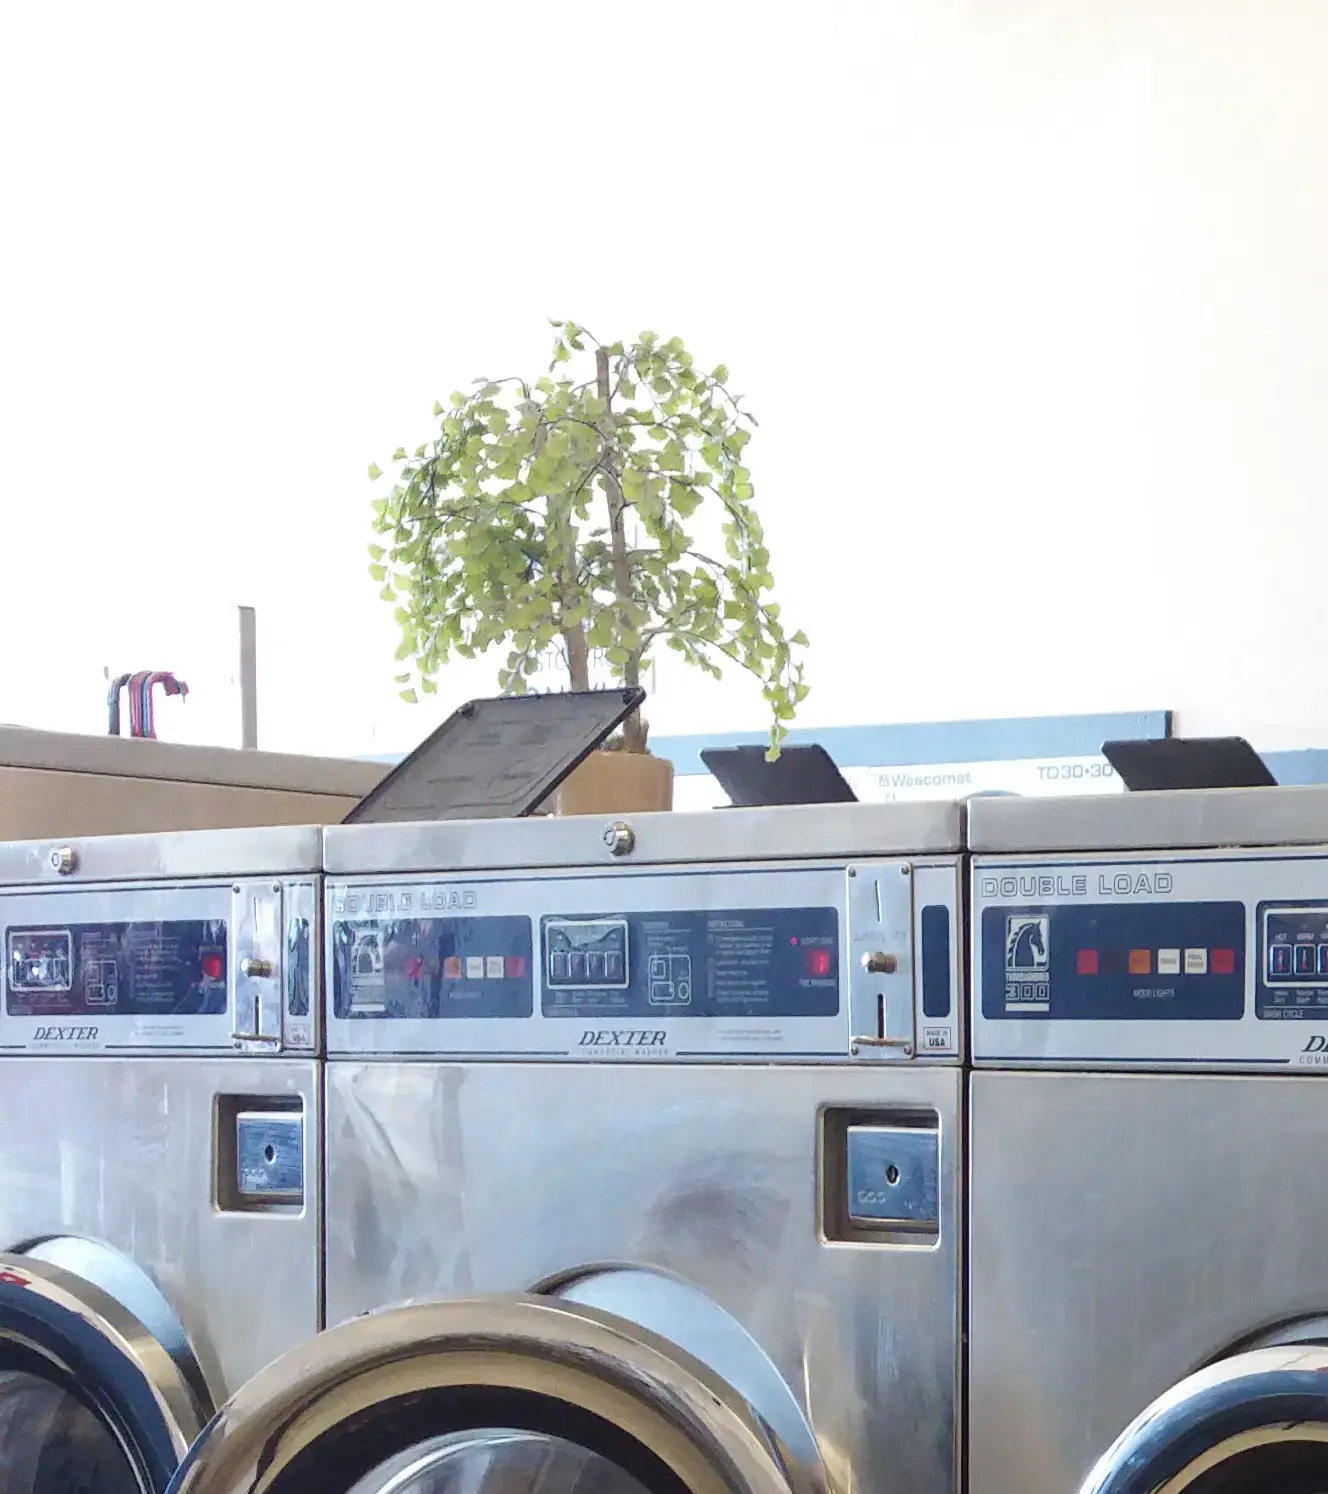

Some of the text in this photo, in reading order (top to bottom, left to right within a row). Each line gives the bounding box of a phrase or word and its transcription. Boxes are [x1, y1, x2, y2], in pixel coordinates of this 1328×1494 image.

[892, 771, 972, 787] Wascomat
[981, 873, 1173, 897] DOUBLE LOAD
[419, 891, 477, 911] LOAD
[34, 1027, 99, 1040] DEXTER
[578, 1030, 667, 1046] DEXTER
[929, 1037, 946, 1047] USA
